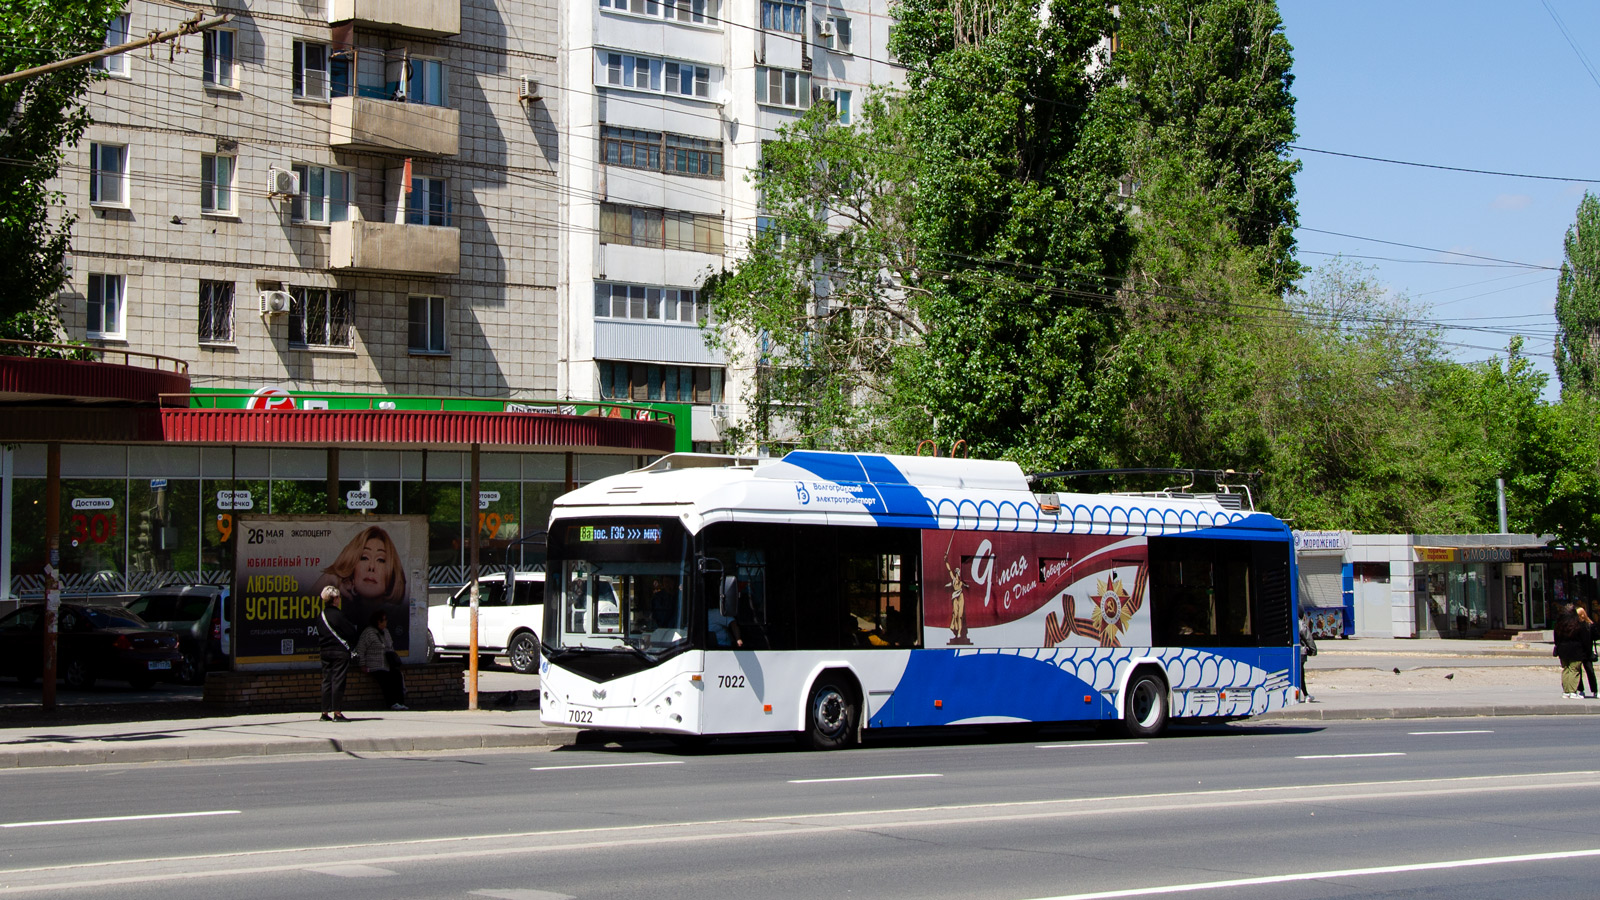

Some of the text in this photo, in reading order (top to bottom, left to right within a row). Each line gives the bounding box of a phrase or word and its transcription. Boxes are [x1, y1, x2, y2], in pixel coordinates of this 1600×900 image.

[812, 482, 864, 493] Волгоградский
[350, 492, 367, 500] Кофе
[816, 496, 876, 506] электротранспорт
[76, 499, 110, 507] Доставка
[356, 499, 374, 507] собой
[71, 513, 109, 544] 30
[610, 526, 625, 540] ГЭС
[248, 529, 332, 544] 26 МАЯ ЭКСПОЦЕНТР
[1303, 538, 1340, 548] МОРОЖЕНОЕ
[1471, 548, 1511, 560] МОЛОКО
[247, 556, 321, 567] ЮБИЛЕЙНЫЙ ТУР
[971, 539, 1029, 607] 9 мая
[246, 575, 299, 593] ЛЮБОВЬ
[245, 596, 342, 621] УСПЕНСК
[718, 675, 745, 688] 7022
[568, 710, 593, 723] 7022
